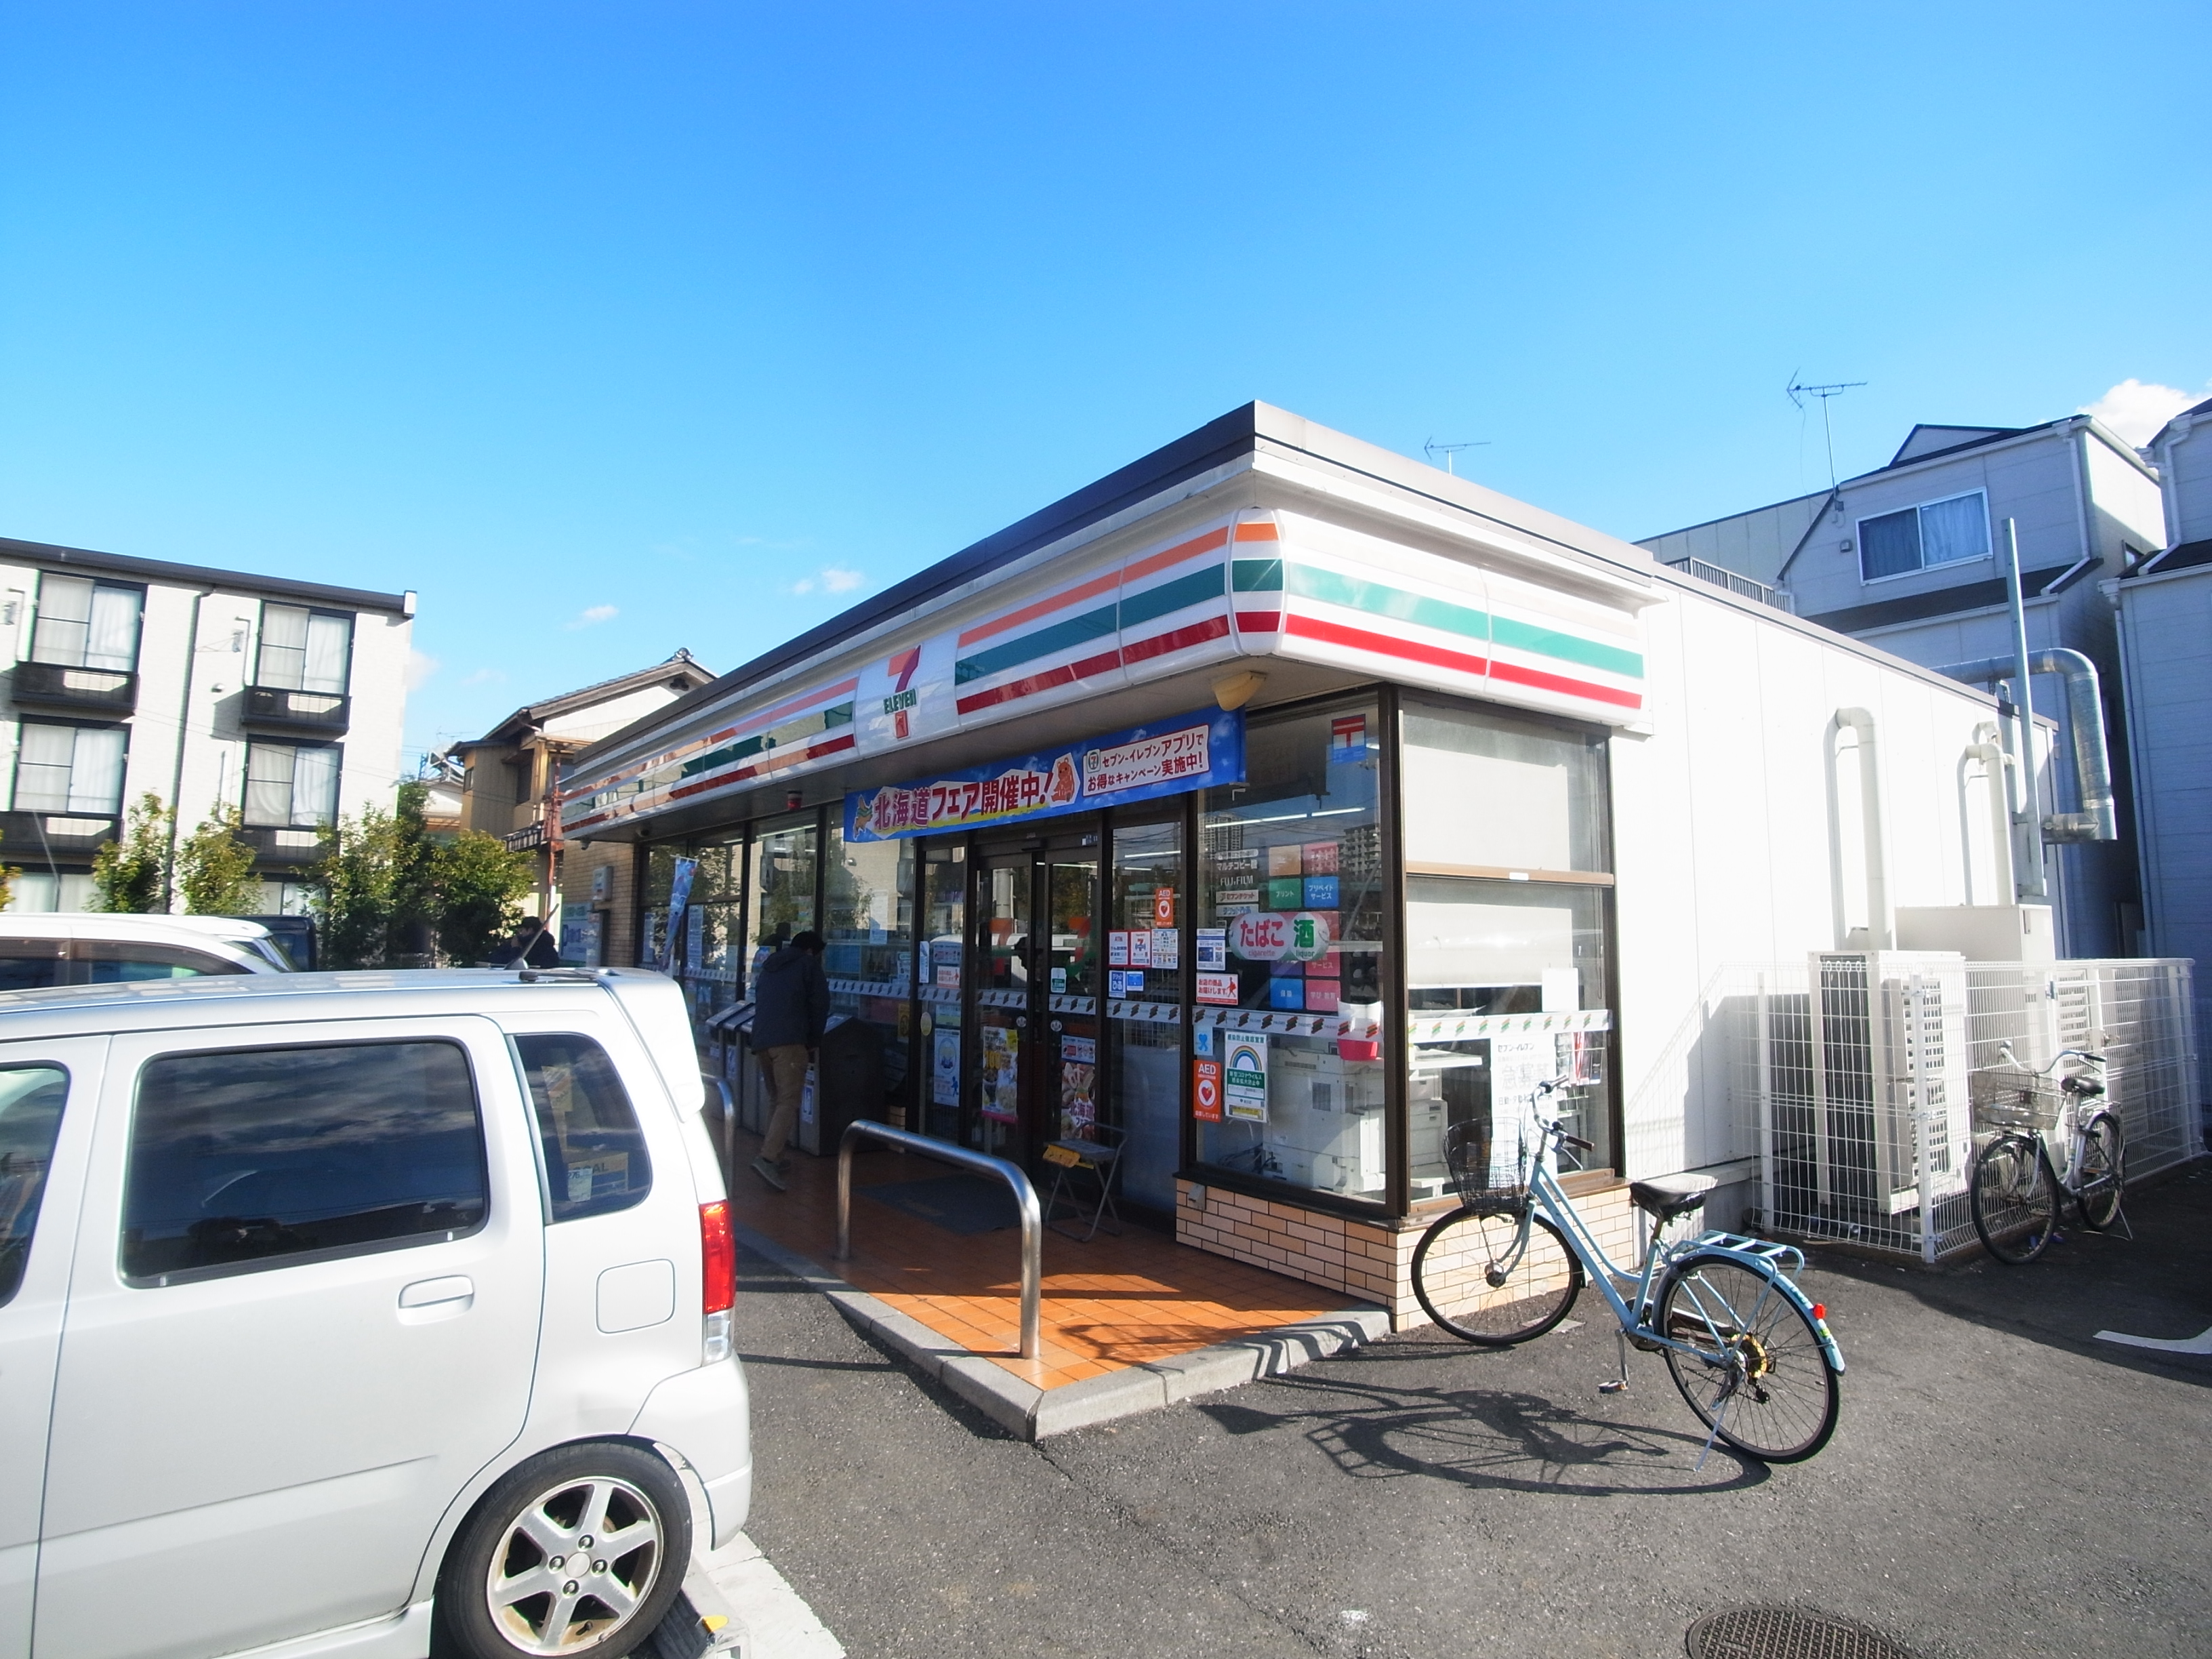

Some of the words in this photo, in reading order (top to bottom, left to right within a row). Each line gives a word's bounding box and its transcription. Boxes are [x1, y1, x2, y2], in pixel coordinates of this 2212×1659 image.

[874, 771, 1054, 830] 北海道フェア開催中!
[1240, 919, 1284, 947] たばこ
[1294, 919, 1315, 948] 酒
[1248, 949, 1275, 958] cigarette
[1296, 949, 1315, 959] liquor
[1198, 1063, 1216, 1075] AED
